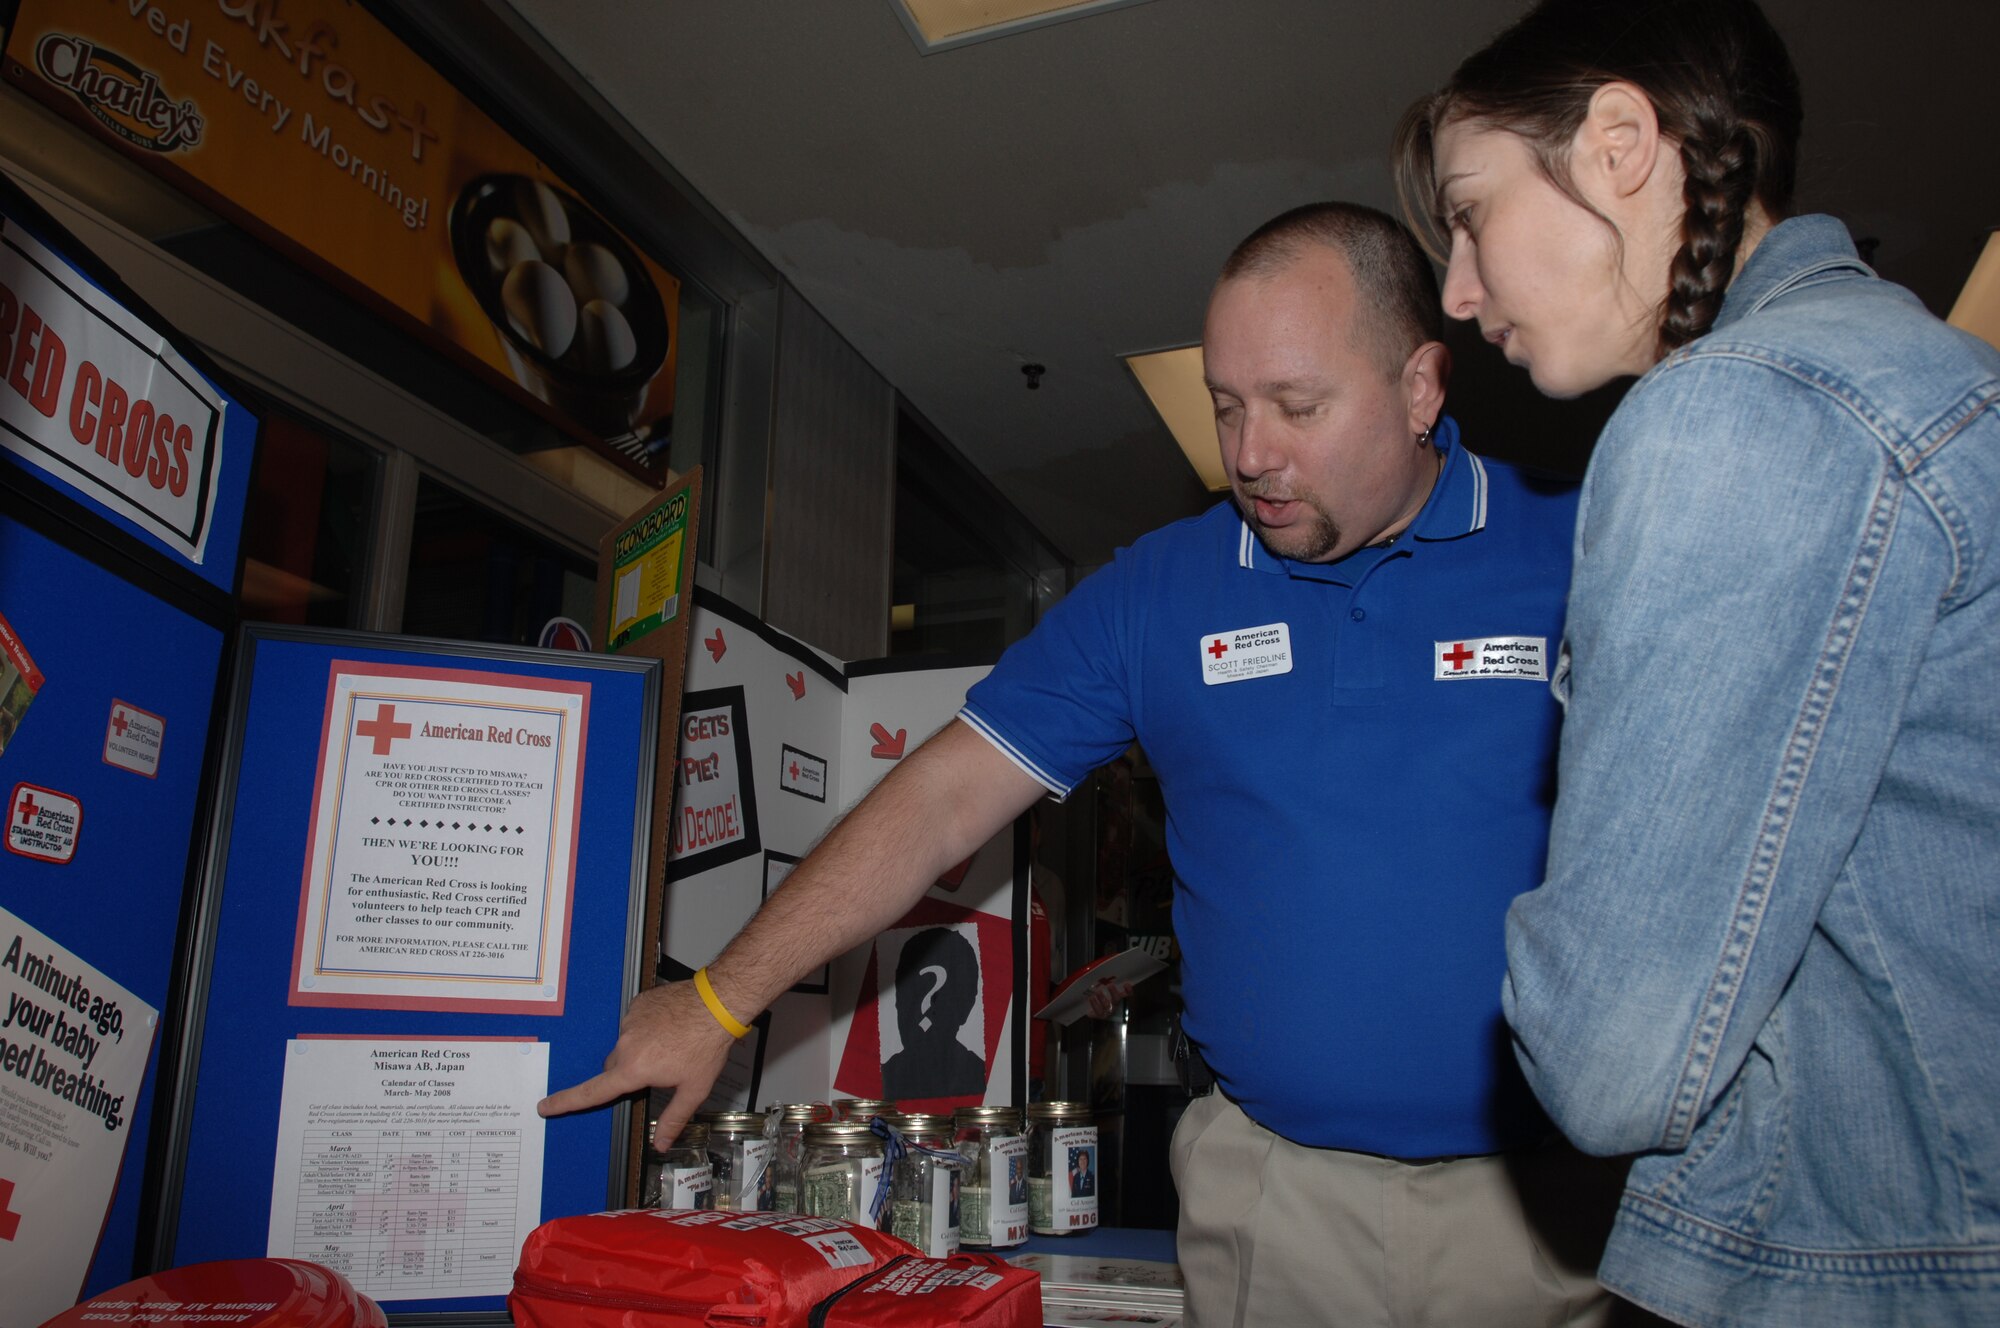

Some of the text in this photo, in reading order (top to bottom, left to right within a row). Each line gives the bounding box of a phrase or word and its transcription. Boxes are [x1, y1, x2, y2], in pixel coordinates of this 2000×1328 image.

[38, 33, 206, 147] Charley's
[110, 0, 428, 229] ved Every Morning!
[0, 281, 194, 498] RED CROSS
[616, 494, 686, 561] ECONOBOARD
[1234, 629, 1280, 642] American
[1235, 637, 1281, 650] Red Cross
[1483, 642, 1539, 652] American
[14, 644, 31, 673] Training
[1208, 652, 1287, 672] SCOTT FRIEDLINE
[1483, 656, 1539, 666] Red Cross
[128, 719, 160, 738] American
[420, 720, 552, 748] American Red Cross
[684, 714, 730, 742] GETS
[126, 730, 160, 749] Red Cross
[109, 742, 156, 764] VOLUNTEER NURSE
[383, 762, 528, 780] HAVE YOU JUST PCS'D TO MISAWA?
[683, 751, 720, 786] PIE?
[802, 766, 820, 777] American
[802, 772, 820, 782] Red Cross
[375, 780, 531, 799] CPR OR OTHER RED CROSS CLASSES?
[384, 772, 403, 780] YOU
[424, 775, 452, 783] CROSS
[453, 776, 499, 786] CERTIFIED
[501, 780, 513, 788] TO
[514, 782, 543, 791] TEACH
[399, 800, 507, 814] CERTIFIED INSTRUCTOR?
[407, 791, 426, 799] YOU
[427, 793, 454, 801] WANT
[468, 795, 505, 805] BECOME
[38, 806, 75, 826] American
[684, 793, 740, 850] DECIDE!
[36, 816, 74, 836] Red Cross
[12, 826, 74, 847] STANDARD FIRST AID
[20, 836, 63, 852] INSTRUCTOR
[362, 837, 525, 857] THEN WE'RE LOOKING FOR
[411, 854, 459, 868] YOU!!!
[350, 873, 528, 893] The American Red Cross is looking
[348, 886, 363, 896] for
[432, 891, 452, 901] Red
[455, 893, 483, 903] Cross
[486, 894, 527, 905] certified
[352, 901, 521, 918] volunteers to help teach CPR and
[355, 914, 383, 923] other
[385, 915, 419, 926] classes
[422, 917, 432, 926] to
[455, 920, 514, 933] community.
[337, 935, 529, 951] FOR MORE INFORMATION, PLEASE CALL THE
[359, 946, 505, 959] AMERICAN RED CROSS AT 226-3016
[1129, 936, 1172, 960] SUB
[2, 935, 125, 1044] A minute ago,
[3, 991, 101, 1071] your baby
[370, 1049, 471, 1059] American Red Cross
[374, 1062, 465, 1073] Misawa AB, Japan
[30, 1047, 124, 1131] breathing.
[414, 1090, 431, 1098] May
[6, 1135, 53, 1162] help. Will you?
[327, 1204, 345, 1212] April
[1069, 1213, 1096, 1227] MDG
[324, 1245, 340, 1254] May
[87, 1301, 278, 1312] Misawa Air Base Japan
[80, 1313, 253, 1323] American Red Cross
